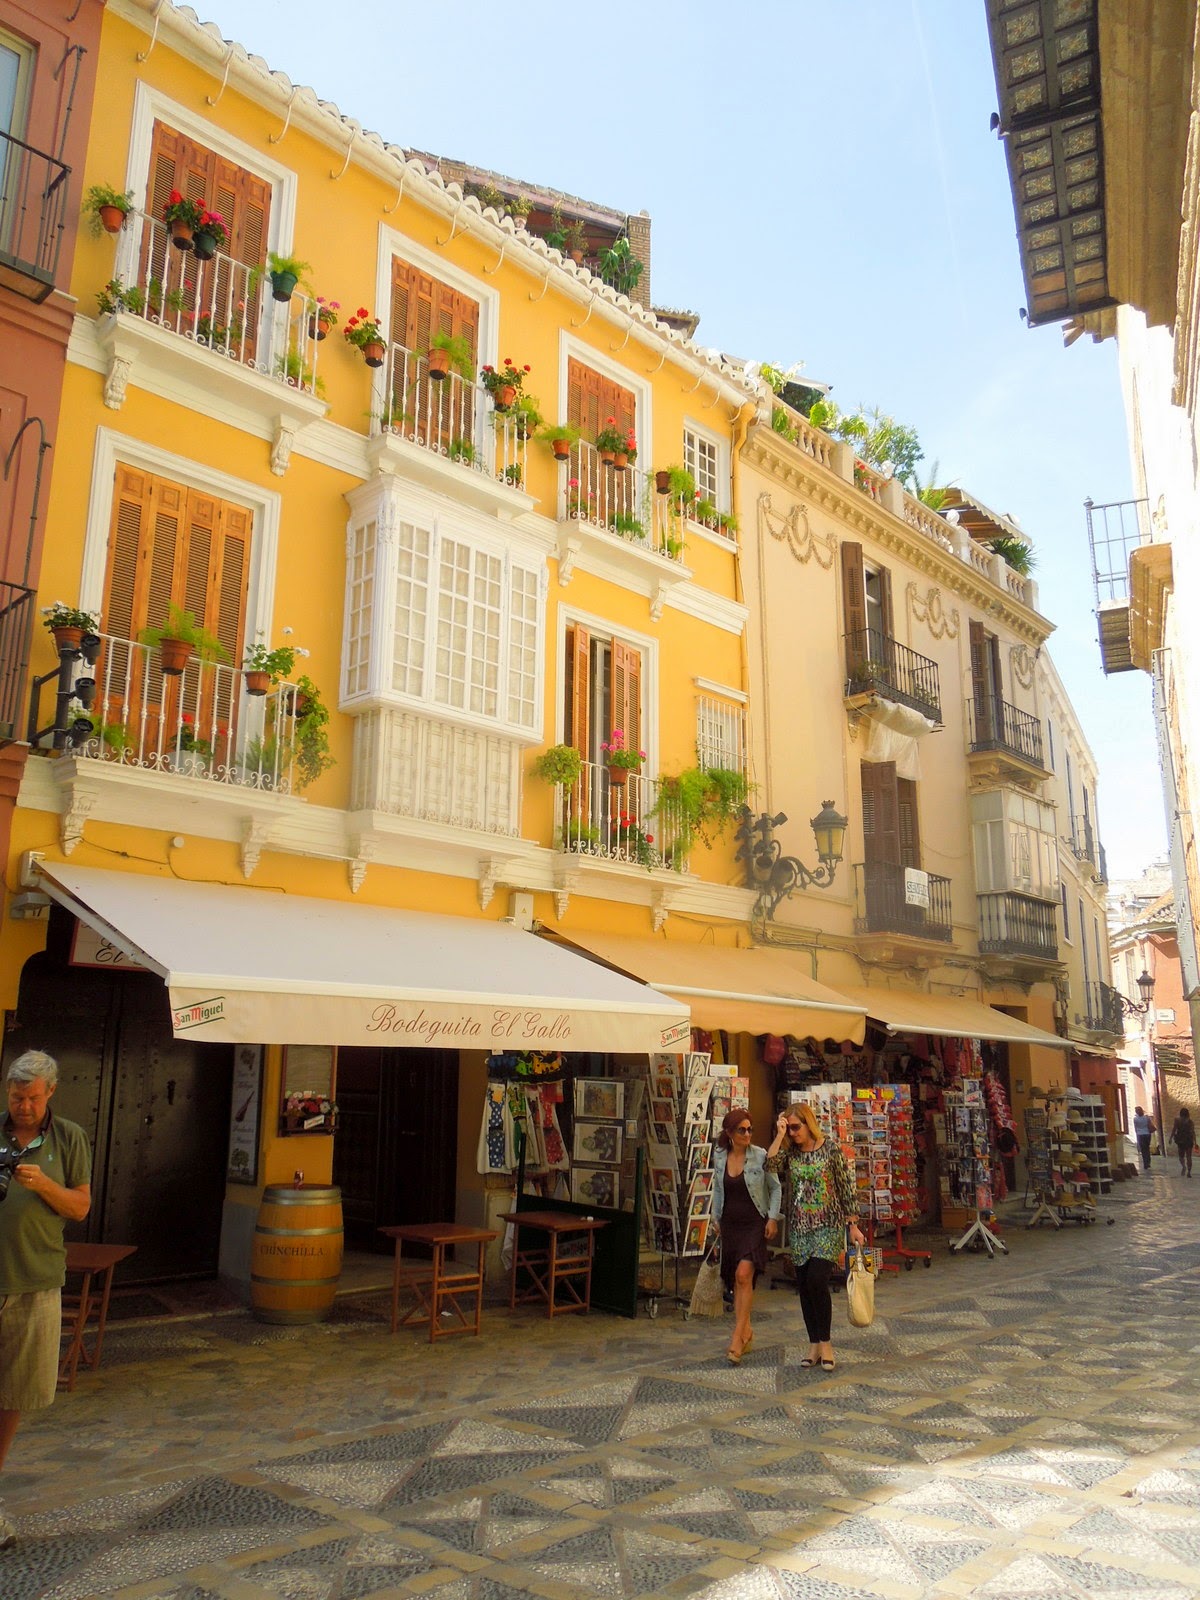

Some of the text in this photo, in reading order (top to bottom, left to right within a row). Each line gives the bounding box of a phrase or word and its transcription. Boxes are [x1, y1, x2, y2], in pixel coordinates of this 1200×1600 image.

[174, 1002, 224, 1027] San Miguel
[365, 1003, 572, 1044] Bodeguita El Gallo
[660, 1032, 673, 1045] San
